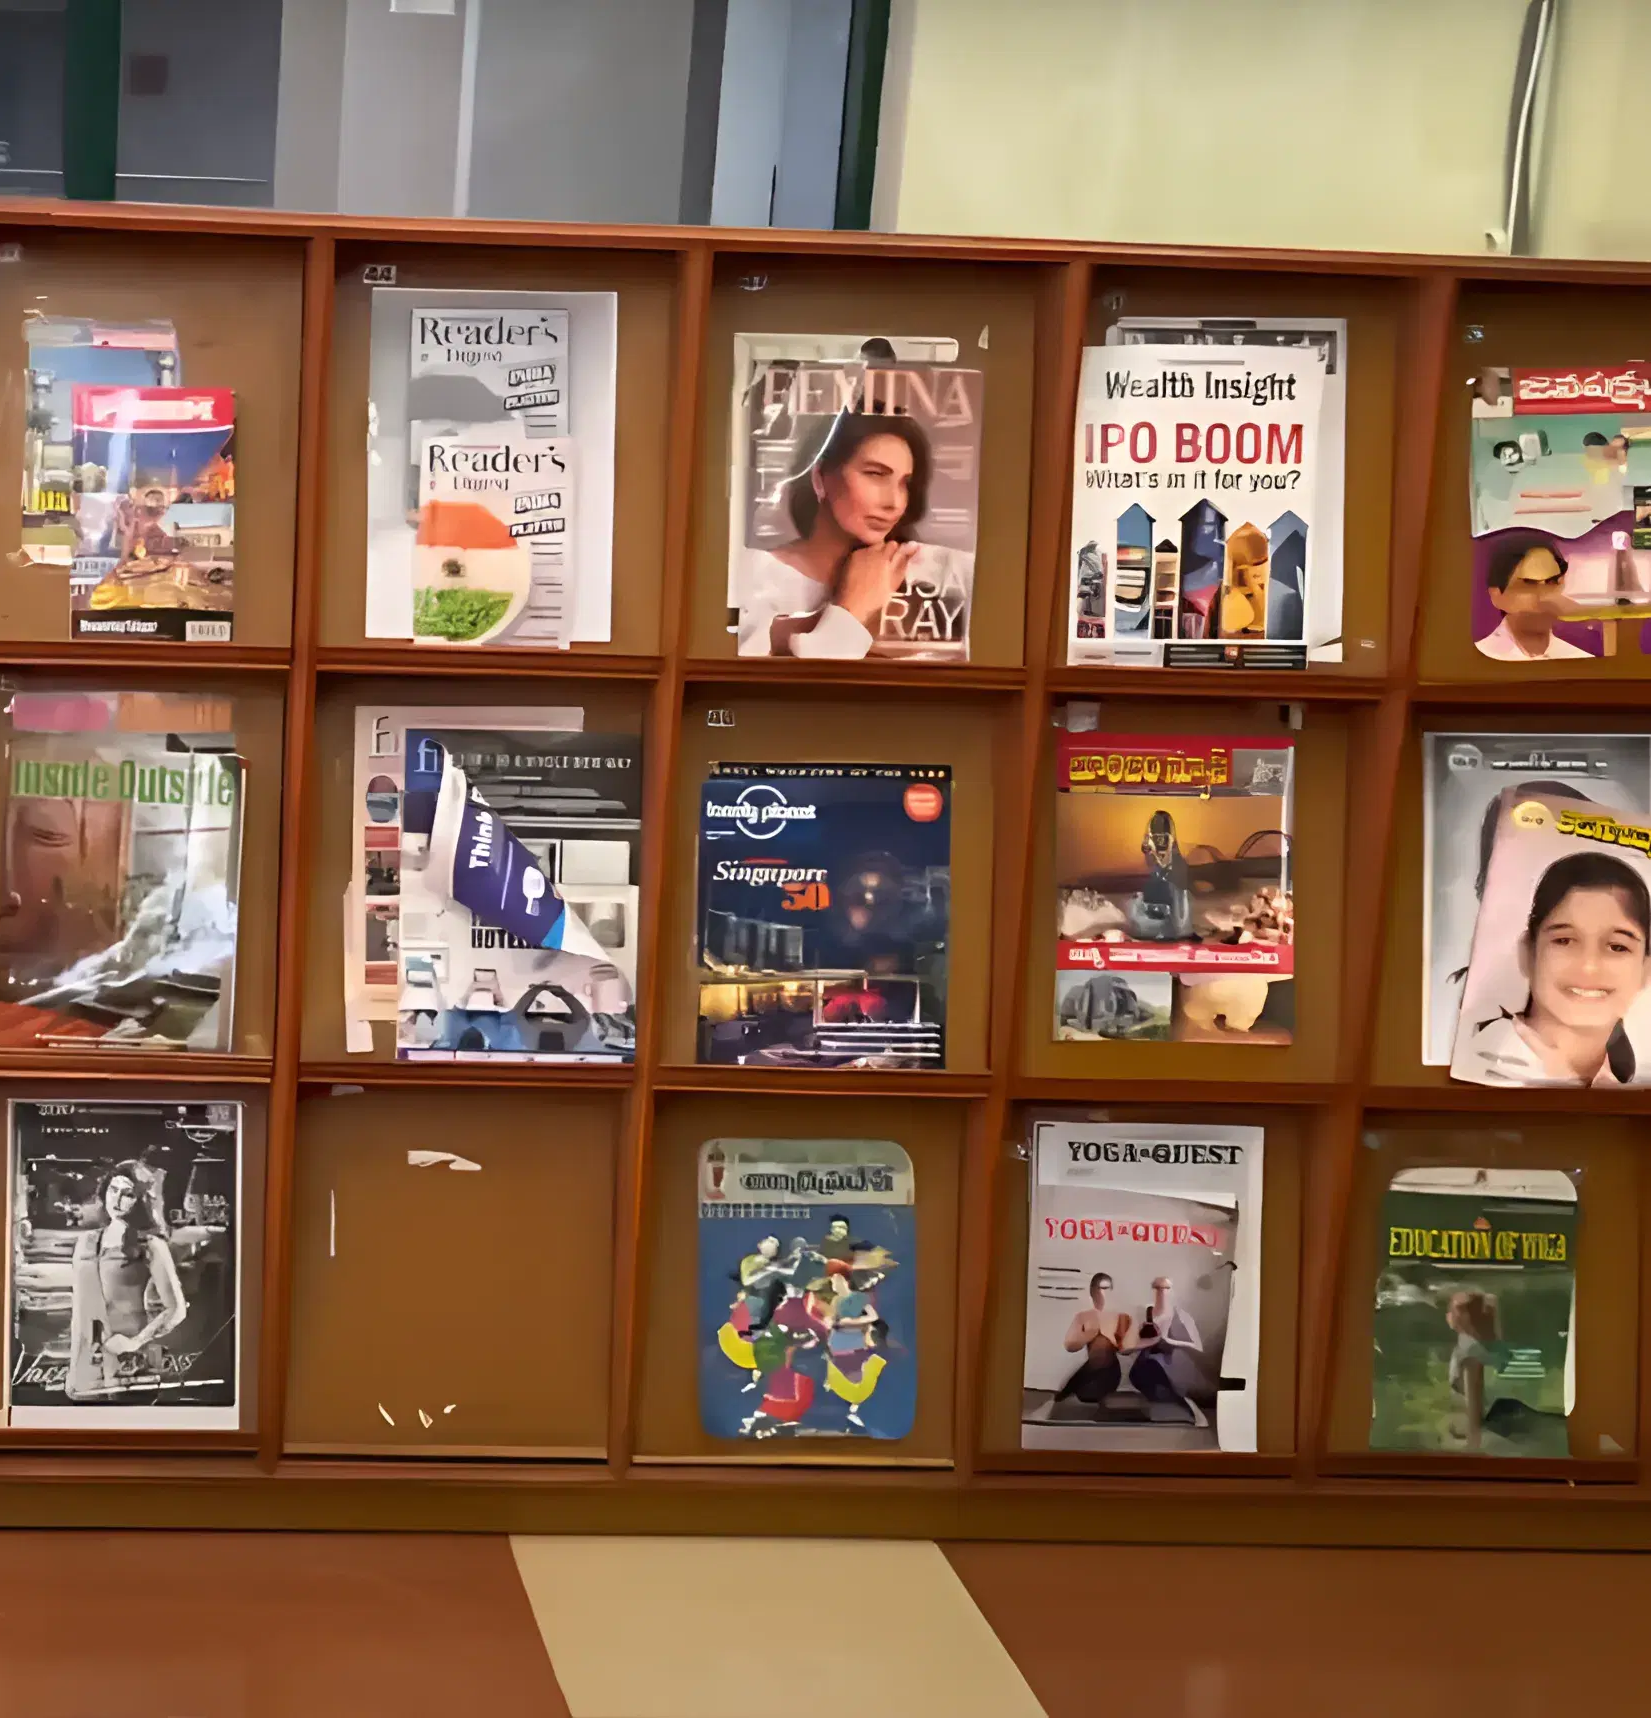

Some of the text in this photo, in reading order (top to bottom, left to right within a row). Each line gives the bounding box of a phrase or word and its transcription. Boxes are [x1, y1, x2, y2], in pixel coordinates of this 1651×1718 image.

[419, 315, 559, 347] Reader's
[1105, 370, 1297, 406] Wealth Insight
[428, 444, 566, 474] Reader's
[1084, 421, 1304, 465] IPO BOOM
[1085, 468, 1302, 493] What's in it for you?
[889, 570, 968, 599] ISA
[879, 598, 966, 640] RAY
[12, 760, 111, 799] Inside
